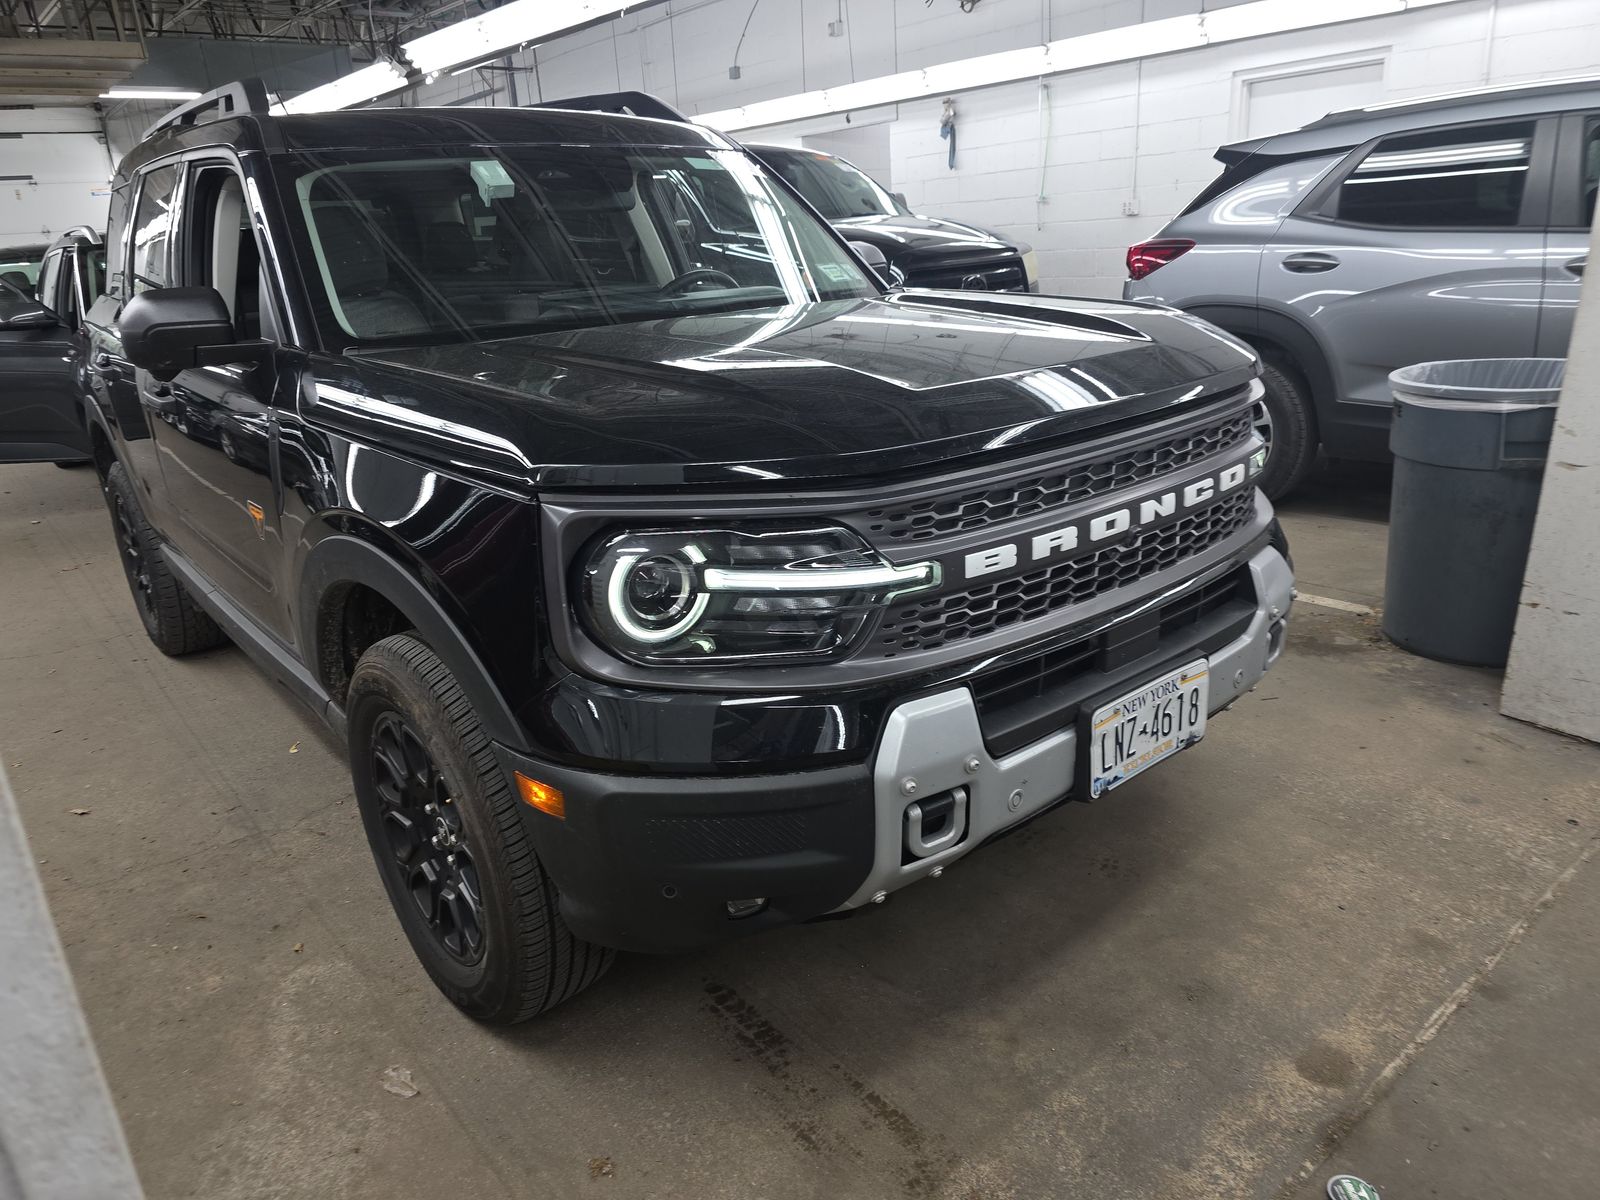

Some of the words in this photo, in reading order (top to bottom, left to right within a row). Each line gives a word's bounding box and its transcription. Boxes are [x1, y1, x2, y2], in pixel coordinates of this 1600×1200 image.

[965, 464, 1245, 578] BRONCO
[1122, 692, 1149, 717] NEW
[1150, 679, 1180, 702] YORK
